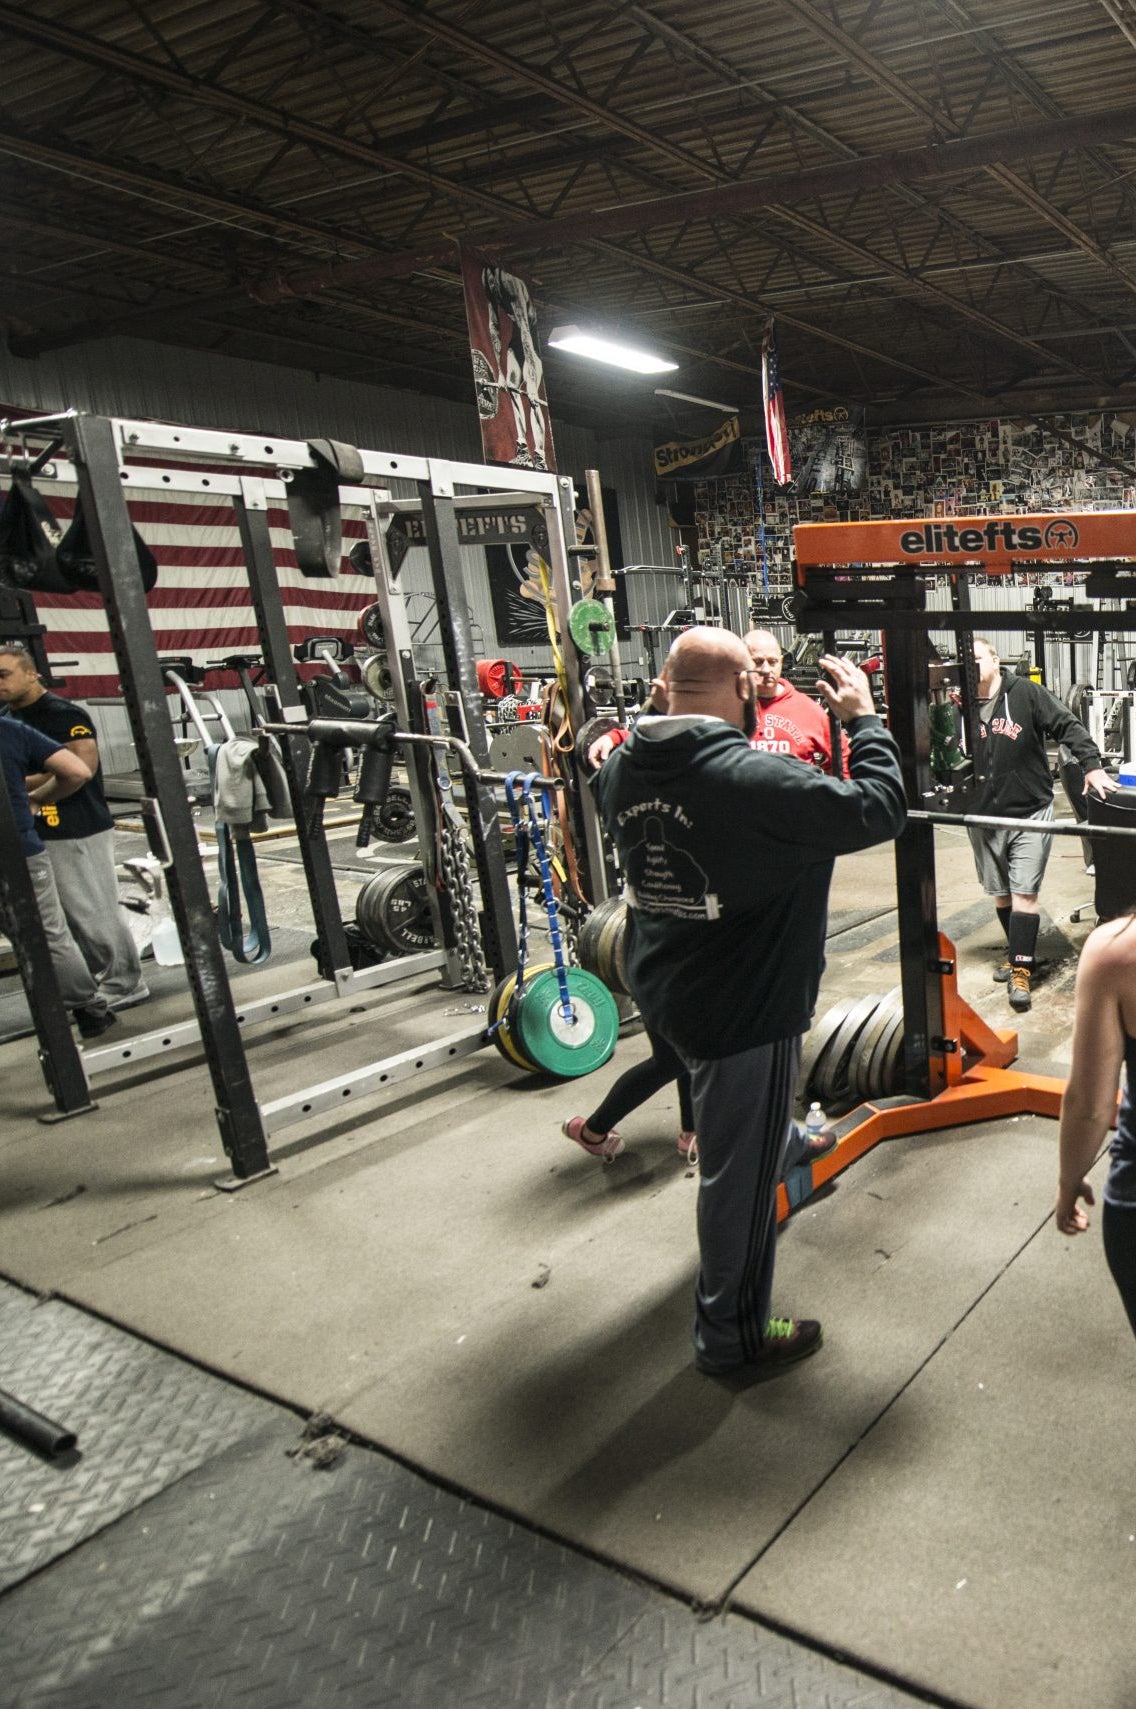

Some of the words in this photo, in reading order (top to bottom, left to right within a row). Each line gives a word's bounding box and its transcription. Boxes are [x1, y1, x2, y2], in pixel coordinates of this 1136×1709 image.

[900, 521, 1043, 553] elitefts
[765, 714, 806, 745] STATE
[750, 739, 791, 753] 1870
[617, 798, 671, 827] Experts
